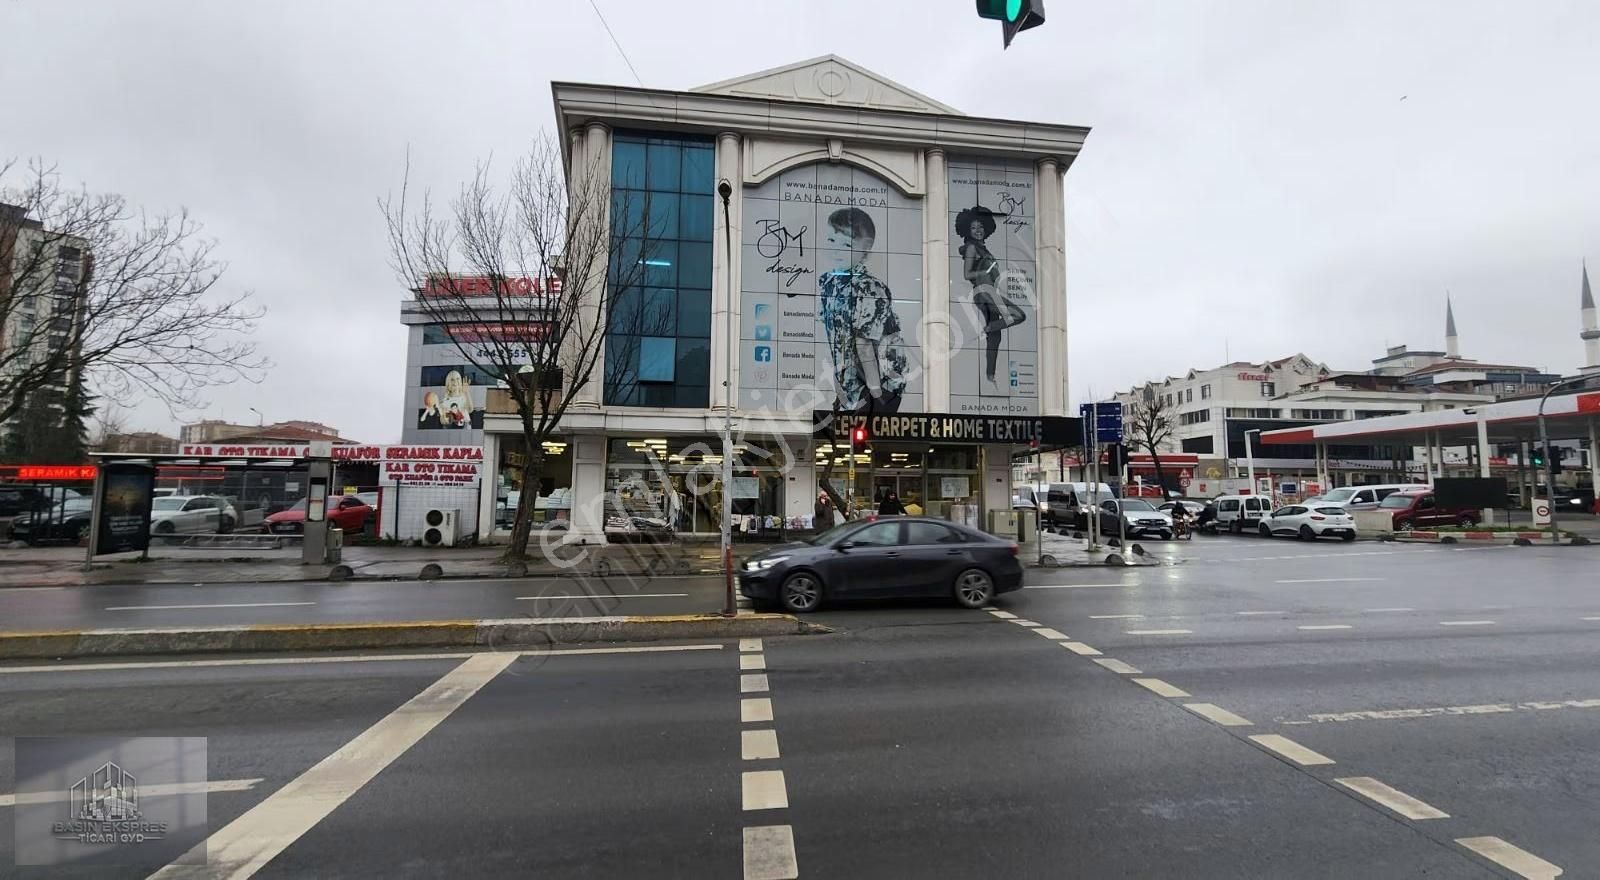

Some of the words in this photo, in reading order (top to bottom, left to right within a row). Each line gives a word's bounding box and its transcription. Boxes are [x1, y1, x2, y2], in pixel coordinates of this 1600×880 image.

[786, 181, 887, 194] www.banadamoda.com.tr
[952, 178, 1032, 189] www.banadamoda.com.tr
[784, 192, 842, 204] BANADA
[847, 197, 887, 207] MODA
[766, 259, 814, 287] design
[961, 404, 999, 412] BANADA
[1001, 405, 1028, 413] MODA
[872, 416, 928, 438] CARPET
[930, 418, 941, 439] &
[943, 418, 983, 439] HOME
[987, 420, 1043, 441] TEXTILE
[183, 446, 213, 456] KAR
[247, 447, 297, 457] YIKAMA
[385, 463, 410, 473] KAR
[413, 463, 436, 473] OTO
[437, 463, 478, 475] YIKAMA
